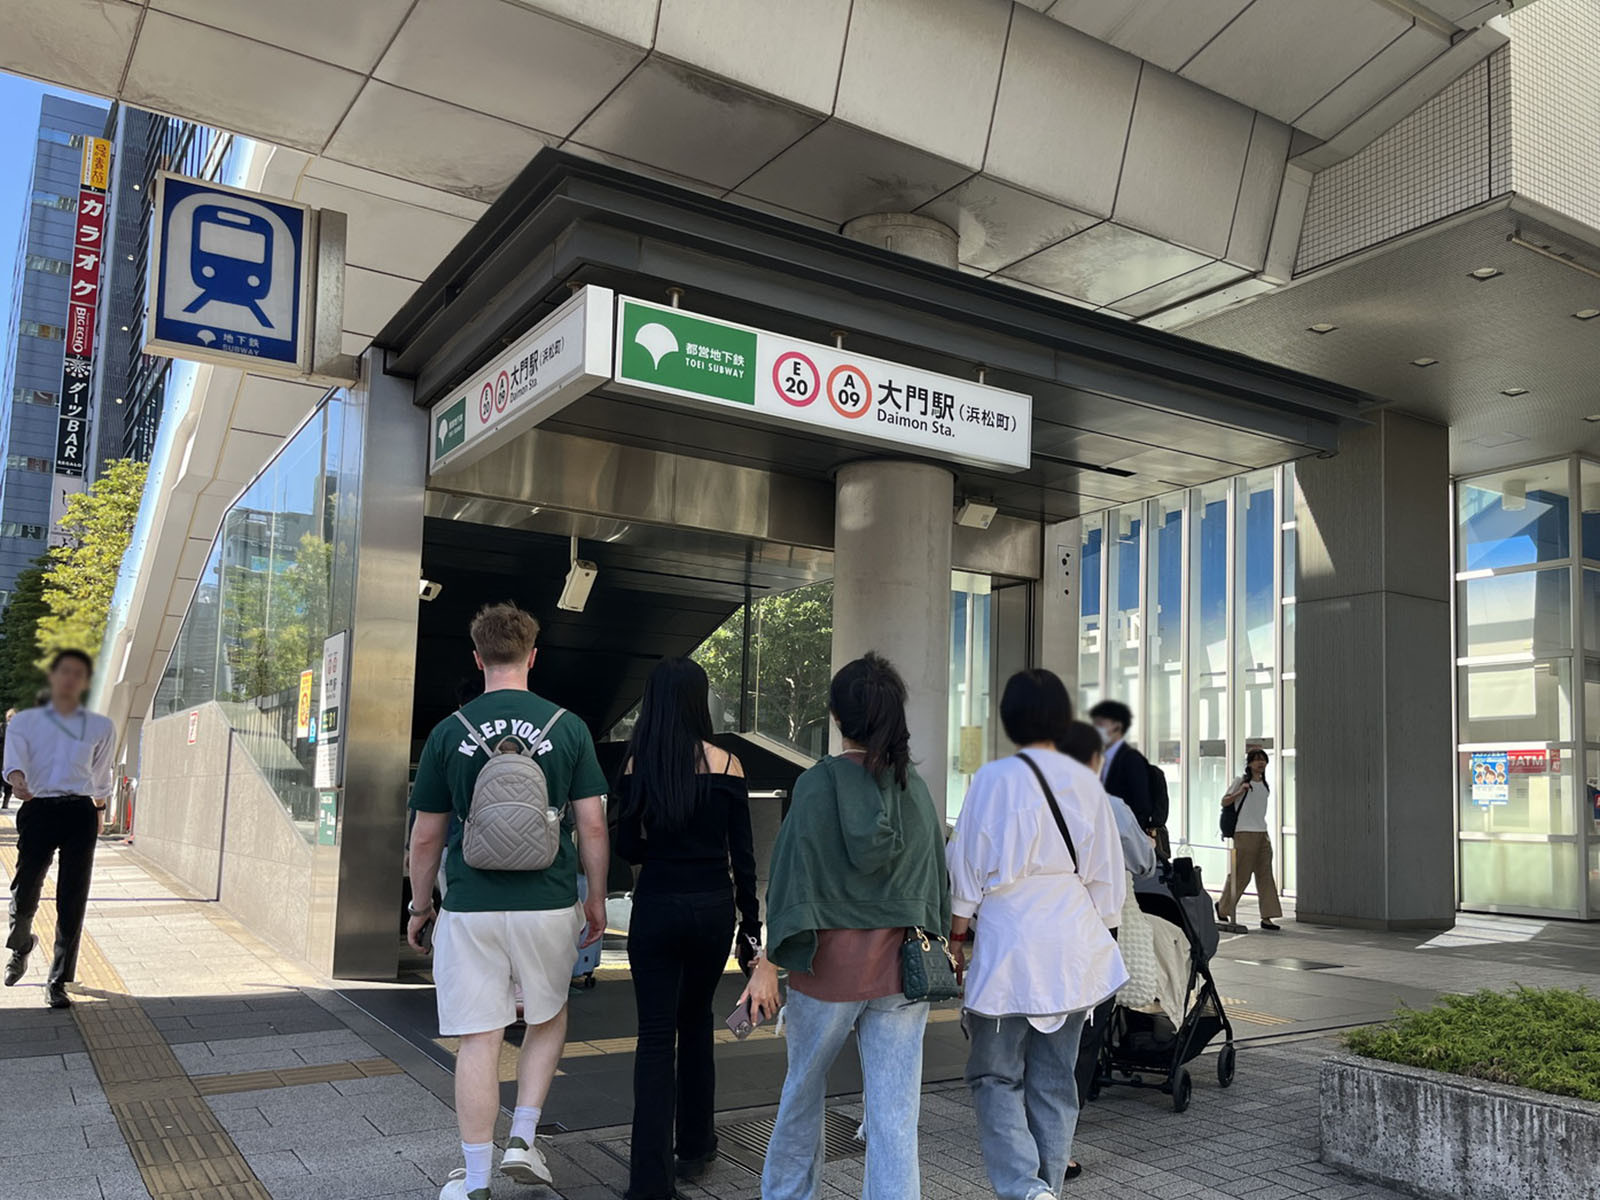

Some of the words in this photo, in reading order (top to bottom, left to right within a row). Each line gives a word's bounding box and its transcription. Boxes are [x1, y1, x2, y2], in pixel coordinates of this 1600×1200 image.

[73, 199, 104, 297] カラオケ
[75, 306, 87, 326] BIG
[72, 326, 85, 353] ECHO
[222, 344, 260, 355] SUBWAY
[223, 333, 260, 348] 地下鉄
[685, 342, 745, 367] 都営地下鉄
[510, 349, 539, 390] 大門駅
[685, 357, 705, 370] TOEI
[708, 362, 745, 379] SUBWAY
[793, 361, 801, 376] E
[785, 377, 808, 396] 20
[843, 374, 856, 389] A
[68, 382, 87, 416] ダーツ
[838, 389, 860, 407] 09
[877, 379, 955, 422] 大門駅
[877, 408, 928, 432] Daimon
[931, 421, 955, 438] Sta.
[64, 419, 80, 459] BAR
[511, 719, 553, 756] YOUR
